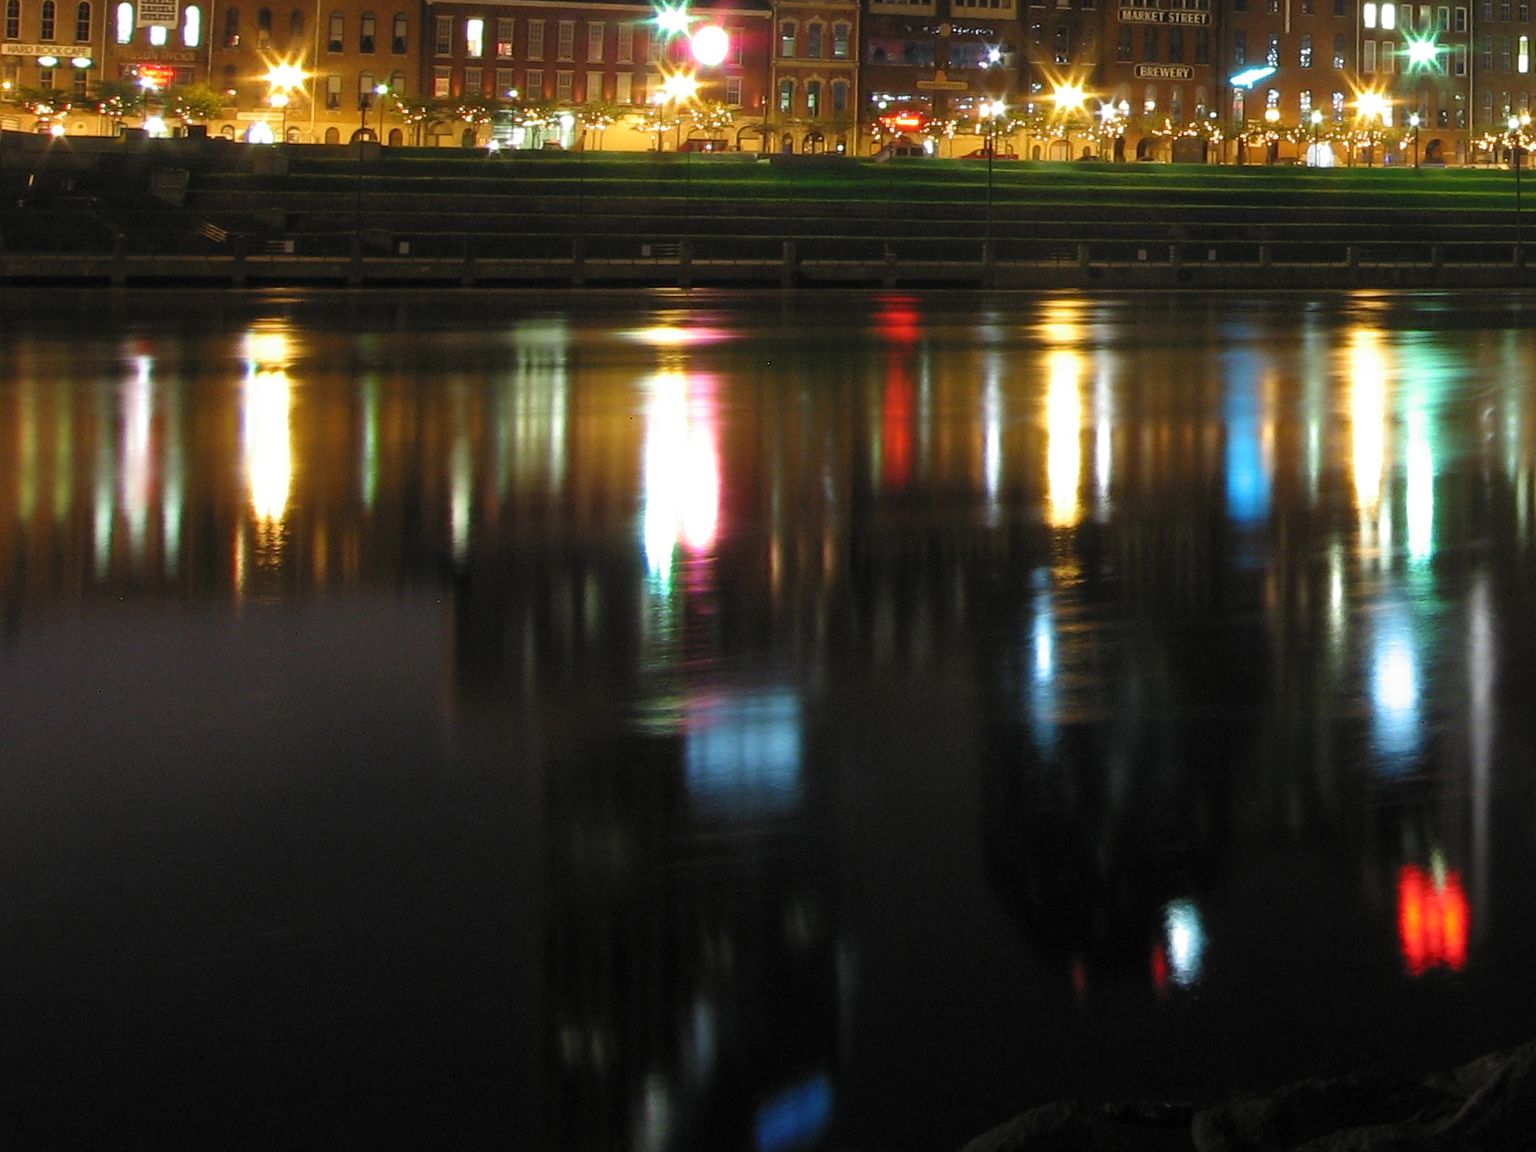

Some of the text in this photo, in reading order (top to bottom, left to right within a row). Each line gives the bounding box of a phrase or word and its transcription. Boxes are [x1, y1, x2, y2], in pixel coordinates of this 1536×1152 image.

[1122, 10, 1206, 24] MARKET STREET
[1140, 66, 1190, 78] BREWERY
